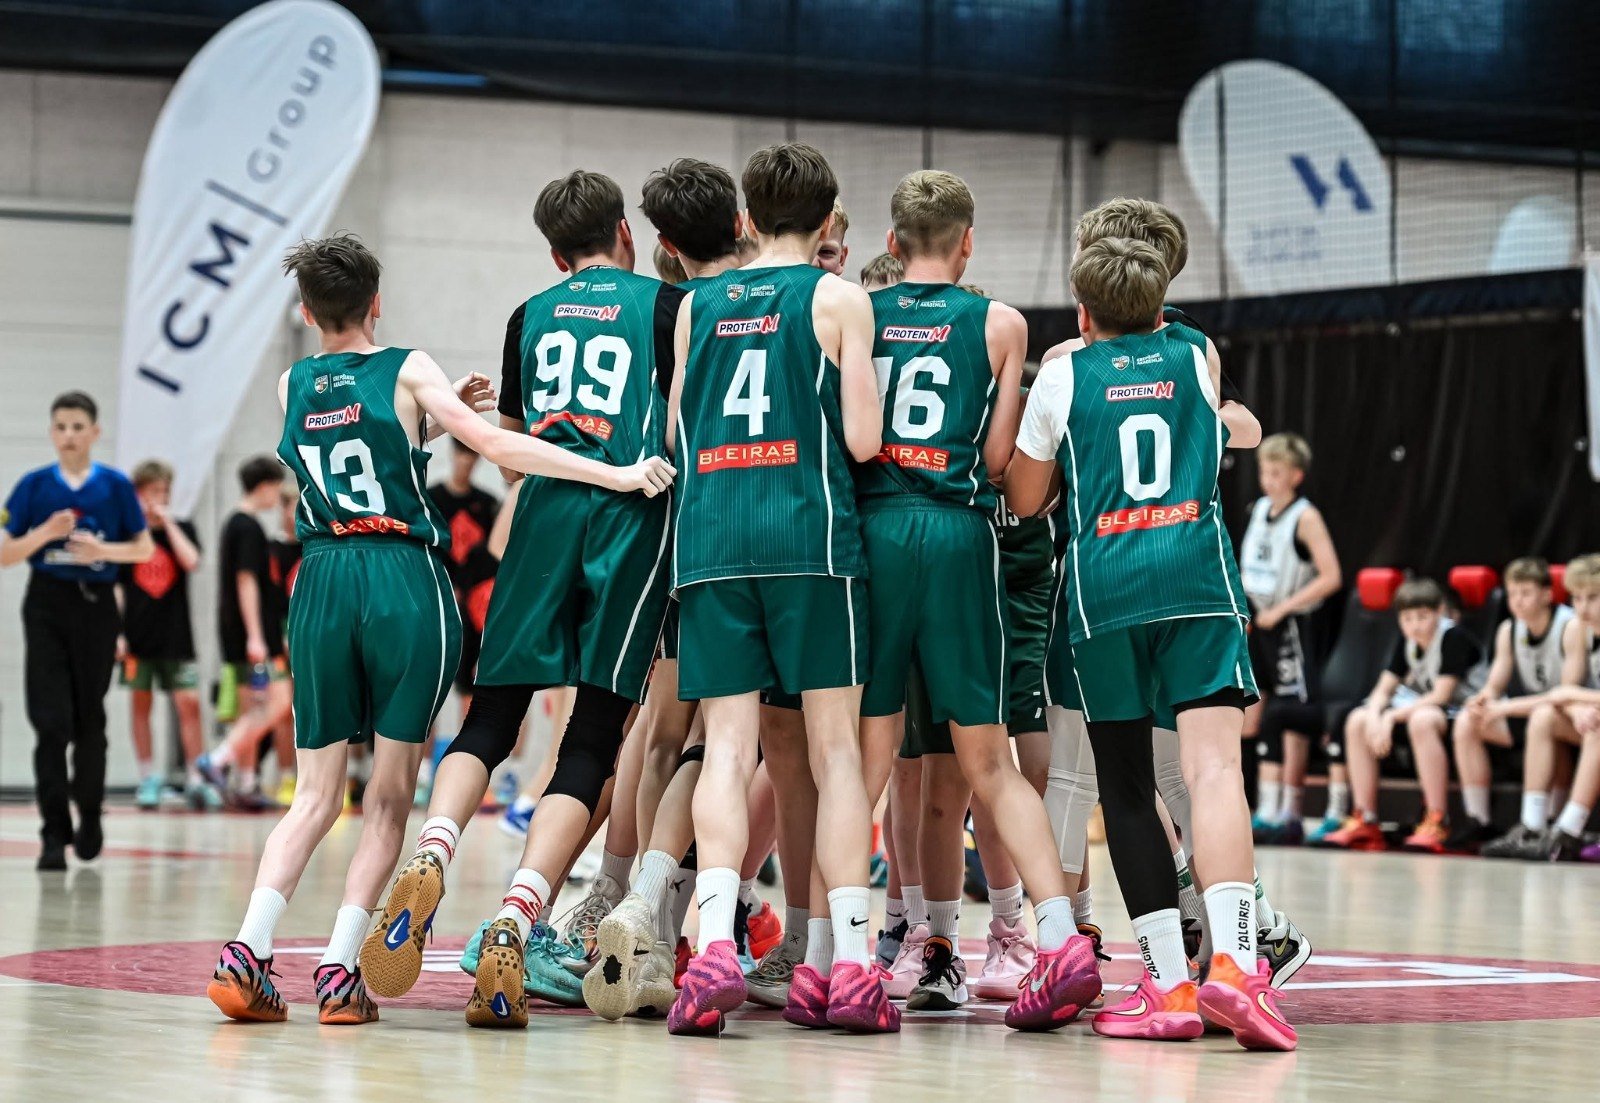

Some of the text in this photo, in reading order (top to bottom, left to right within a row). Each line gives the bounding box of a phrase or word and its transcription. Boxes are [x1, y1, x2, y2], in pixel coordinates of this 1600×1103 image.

[138, 34, 338, 394] ICM Group
[532, 330, 632, 415] 99
[723, 349, 771, 437] 4
[872, 355, 951, 440] 16
[298, 438, 386, 515] 13
[699, 443, 796, 466] BLEIRAS
[750, 457, 796, 466] LOGISTICS
[899, 460, 946, 473] LOGISTICS
[1118, 413, 1172, 501] 0
[1098, 502, 1198, 530] BLEIRAS
